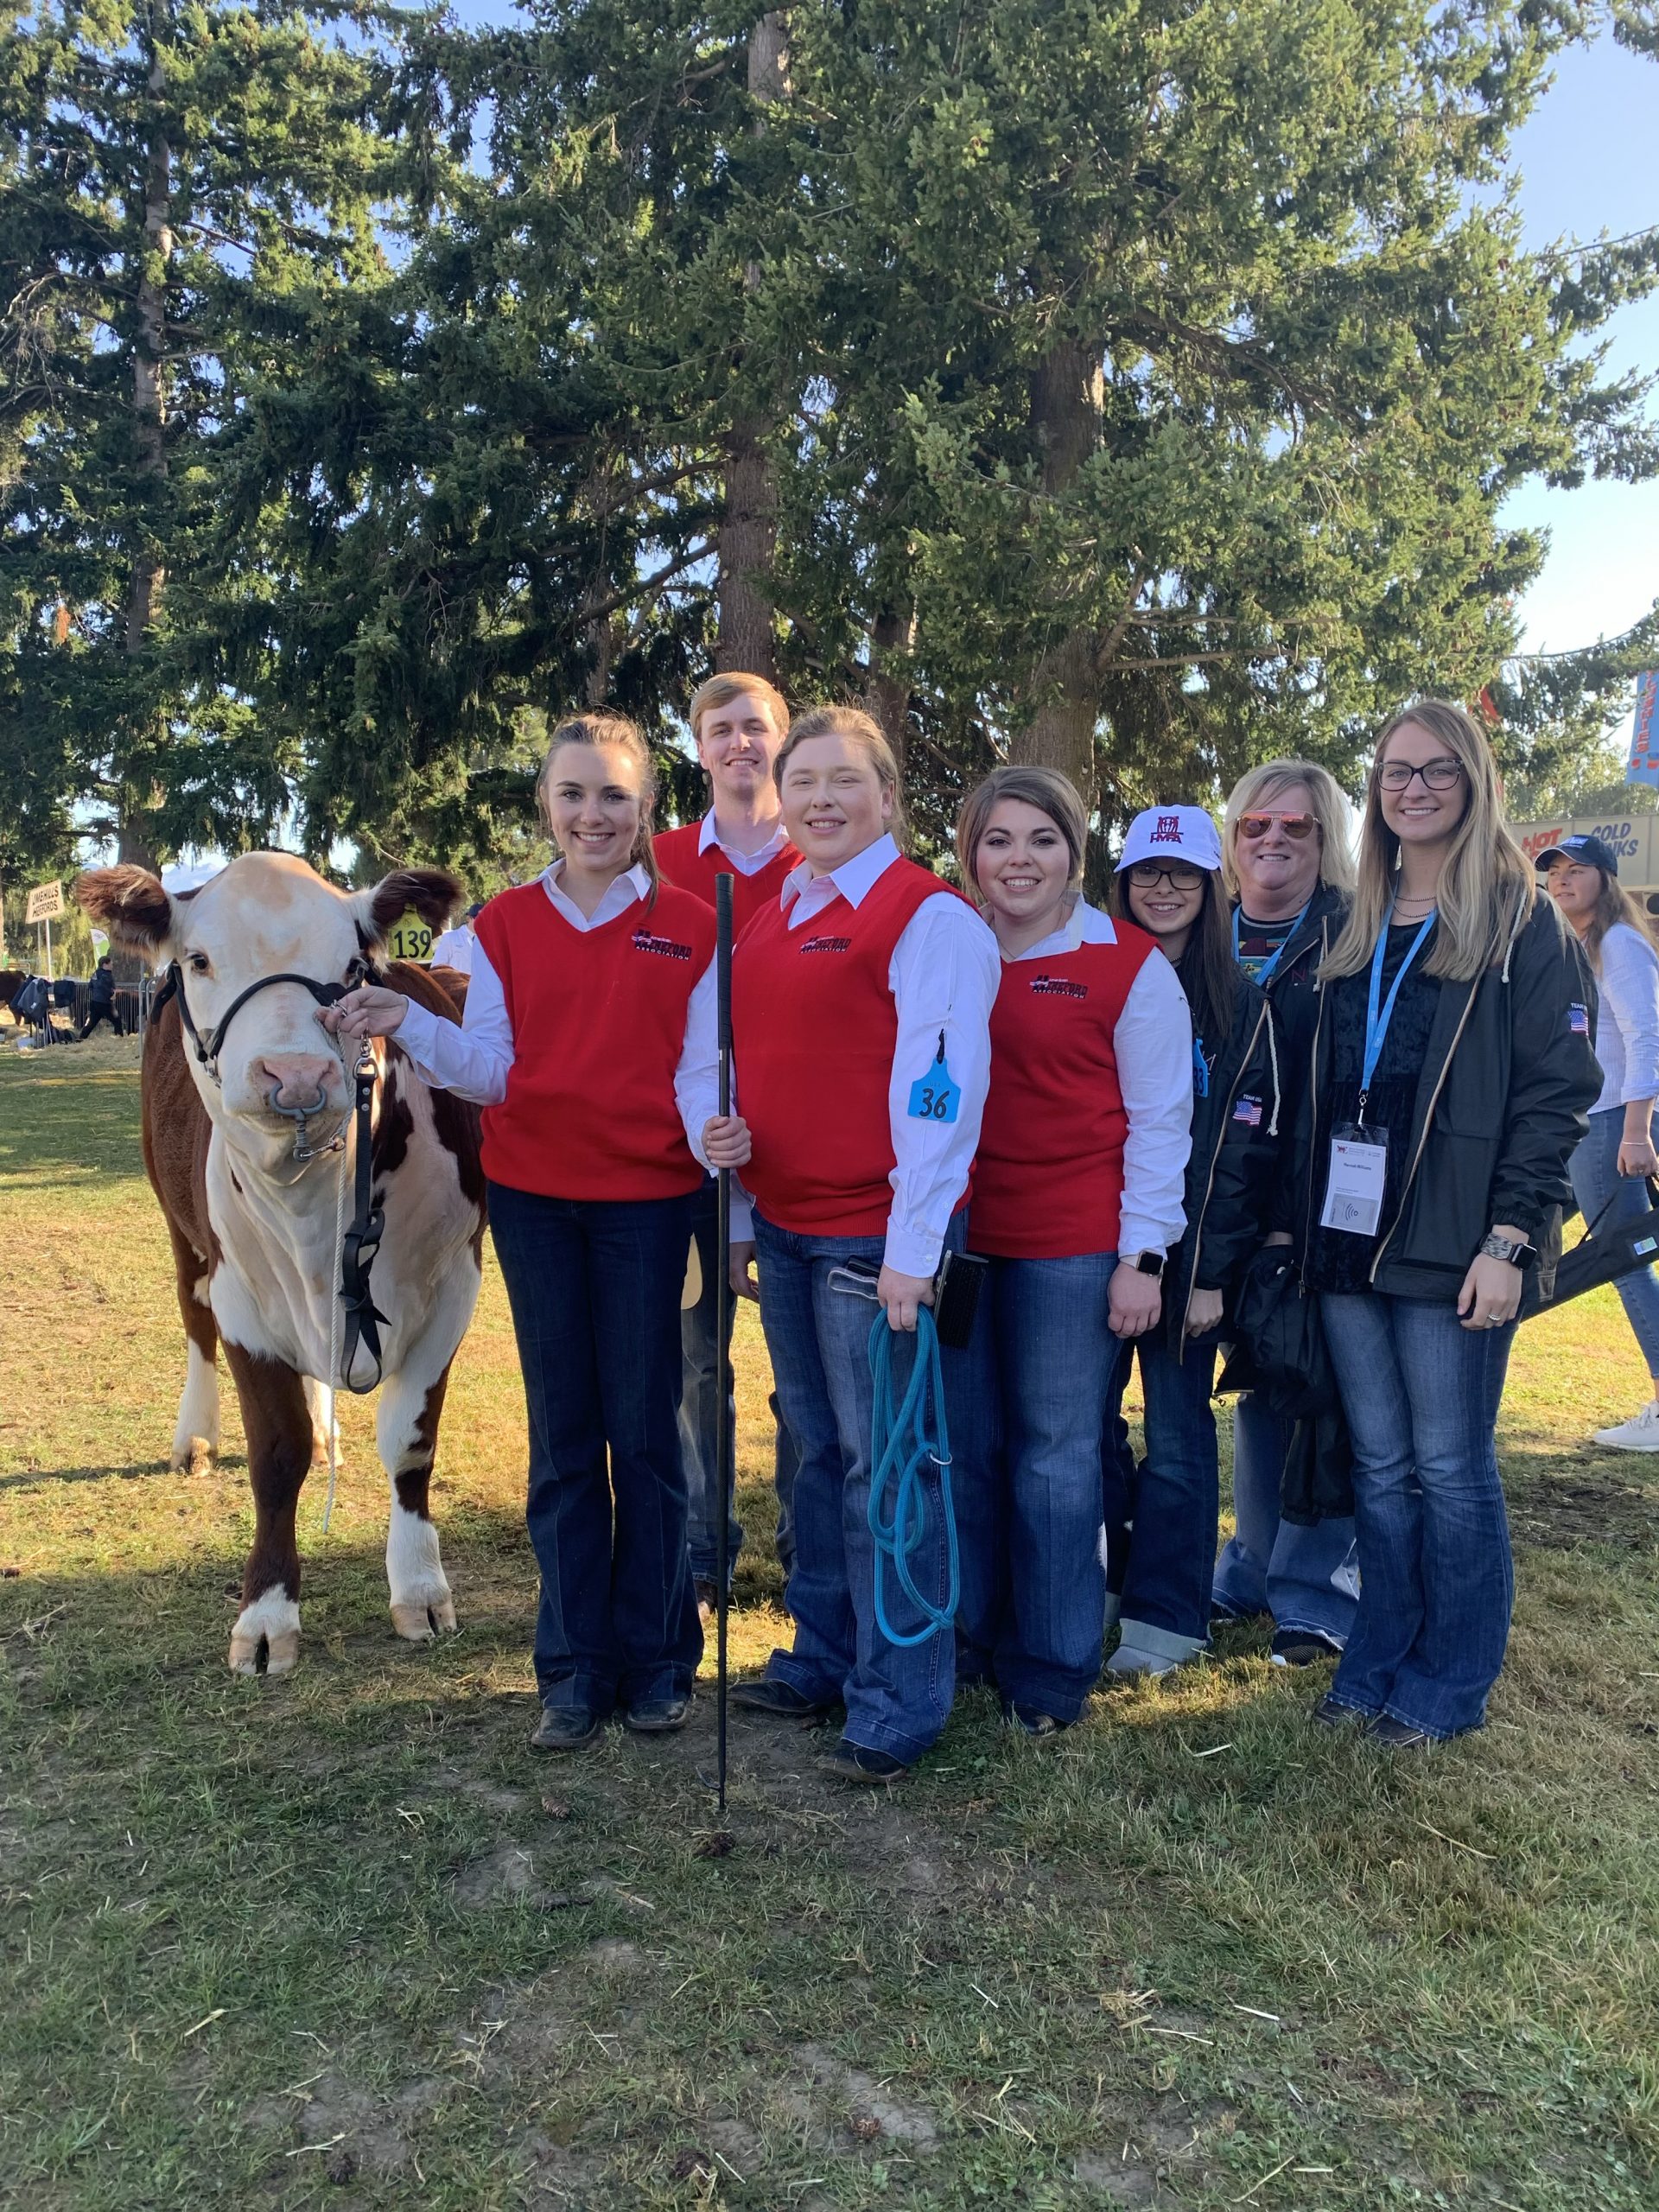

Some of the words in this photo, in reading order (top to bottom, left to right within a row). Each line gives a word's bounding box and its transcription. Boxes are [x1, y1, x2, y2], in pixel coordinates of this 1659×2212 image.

[1522, 828, 1563, 851] HOT
[1591, 823, 1631, 842] COLD
[1609, 839, 1639, 858] NKS
[394, 930, 430, 958] 139
[636, 945, 690, 961] ASSOCIATION
[1033, 988, 1085, 999] ASSOCIATION
[918, 1088, 950, 1118] 36
